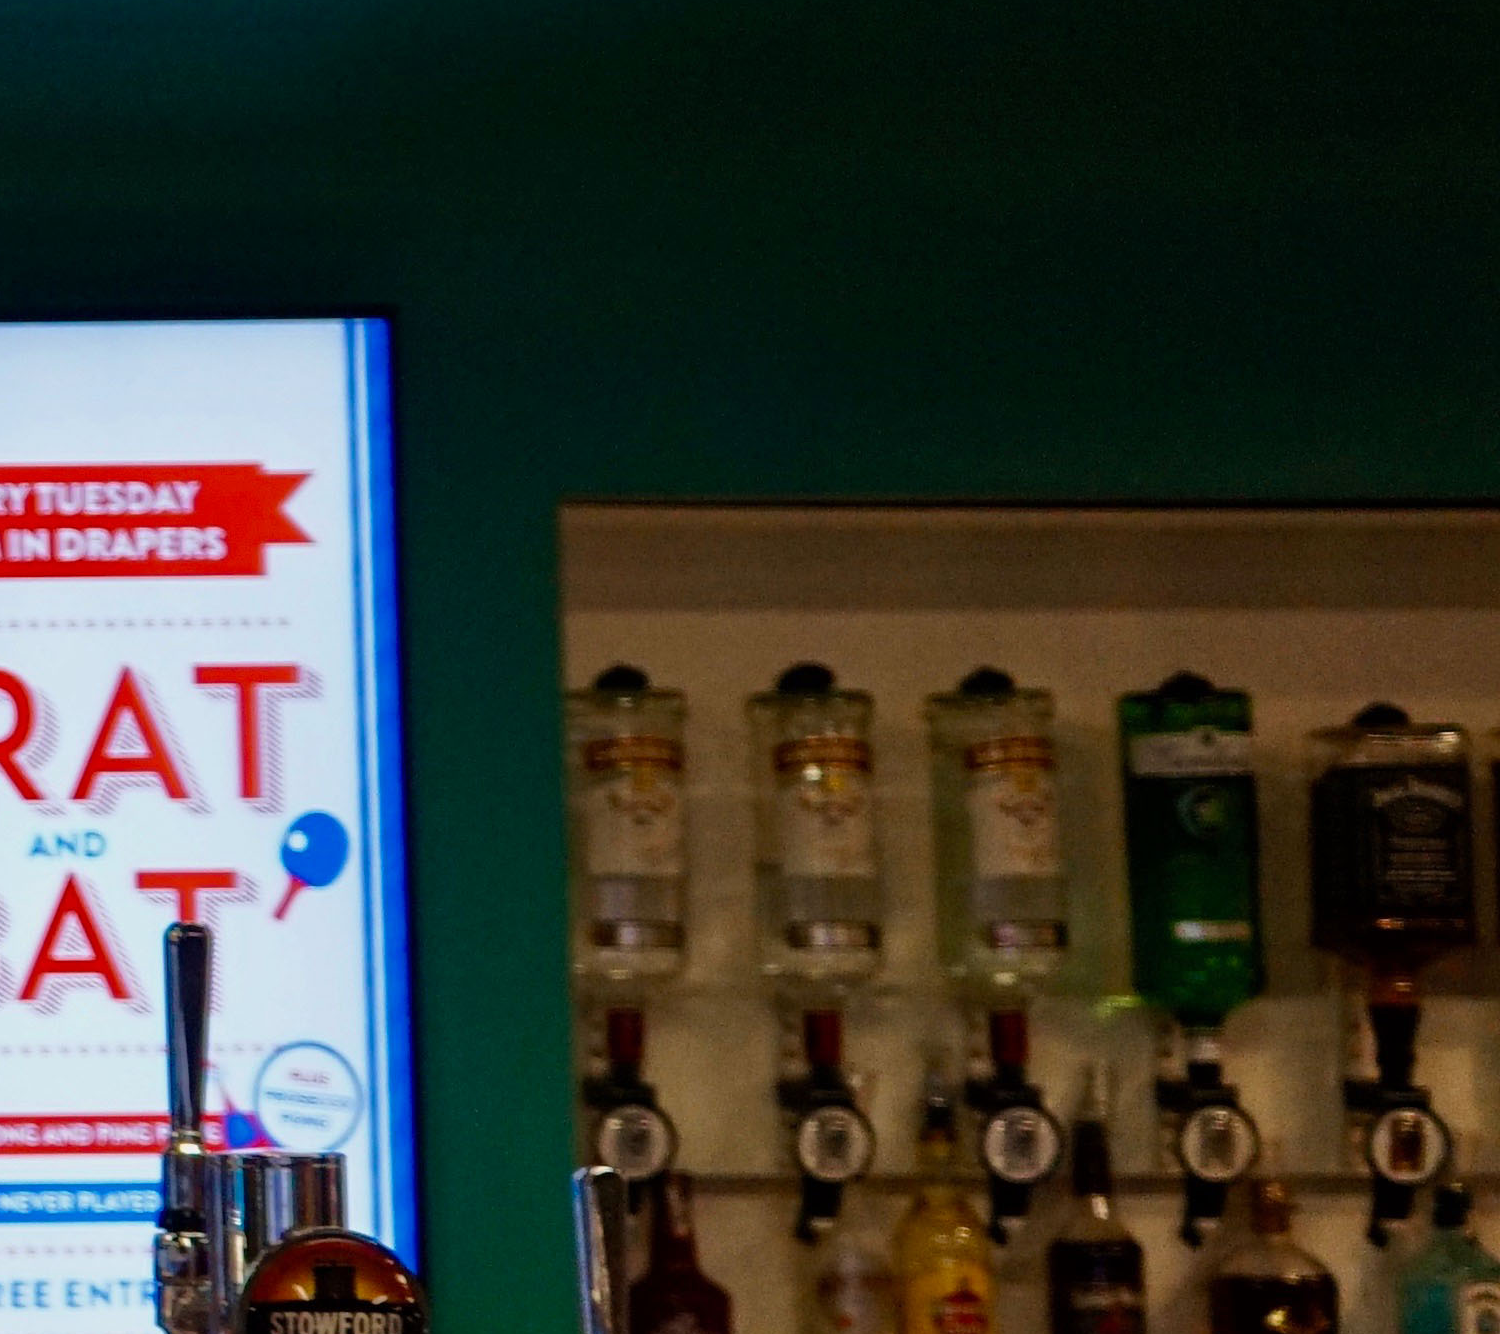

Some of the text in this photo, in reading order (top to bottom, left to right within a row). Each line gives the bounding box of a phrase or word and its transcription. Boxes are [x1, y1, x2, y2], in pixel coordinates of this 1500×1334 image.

[36, 479, 201, 514] TUESDAY
[7, 529, 48, 562] IN
[55, 526, 228, 562] DRAPERS
[27, 828, 108, 859] AND
[42, 1123, 95, 1146] AND
[99, 1122, 152, 1146] PING
[0, 1192, 73, 1215] NEVER
